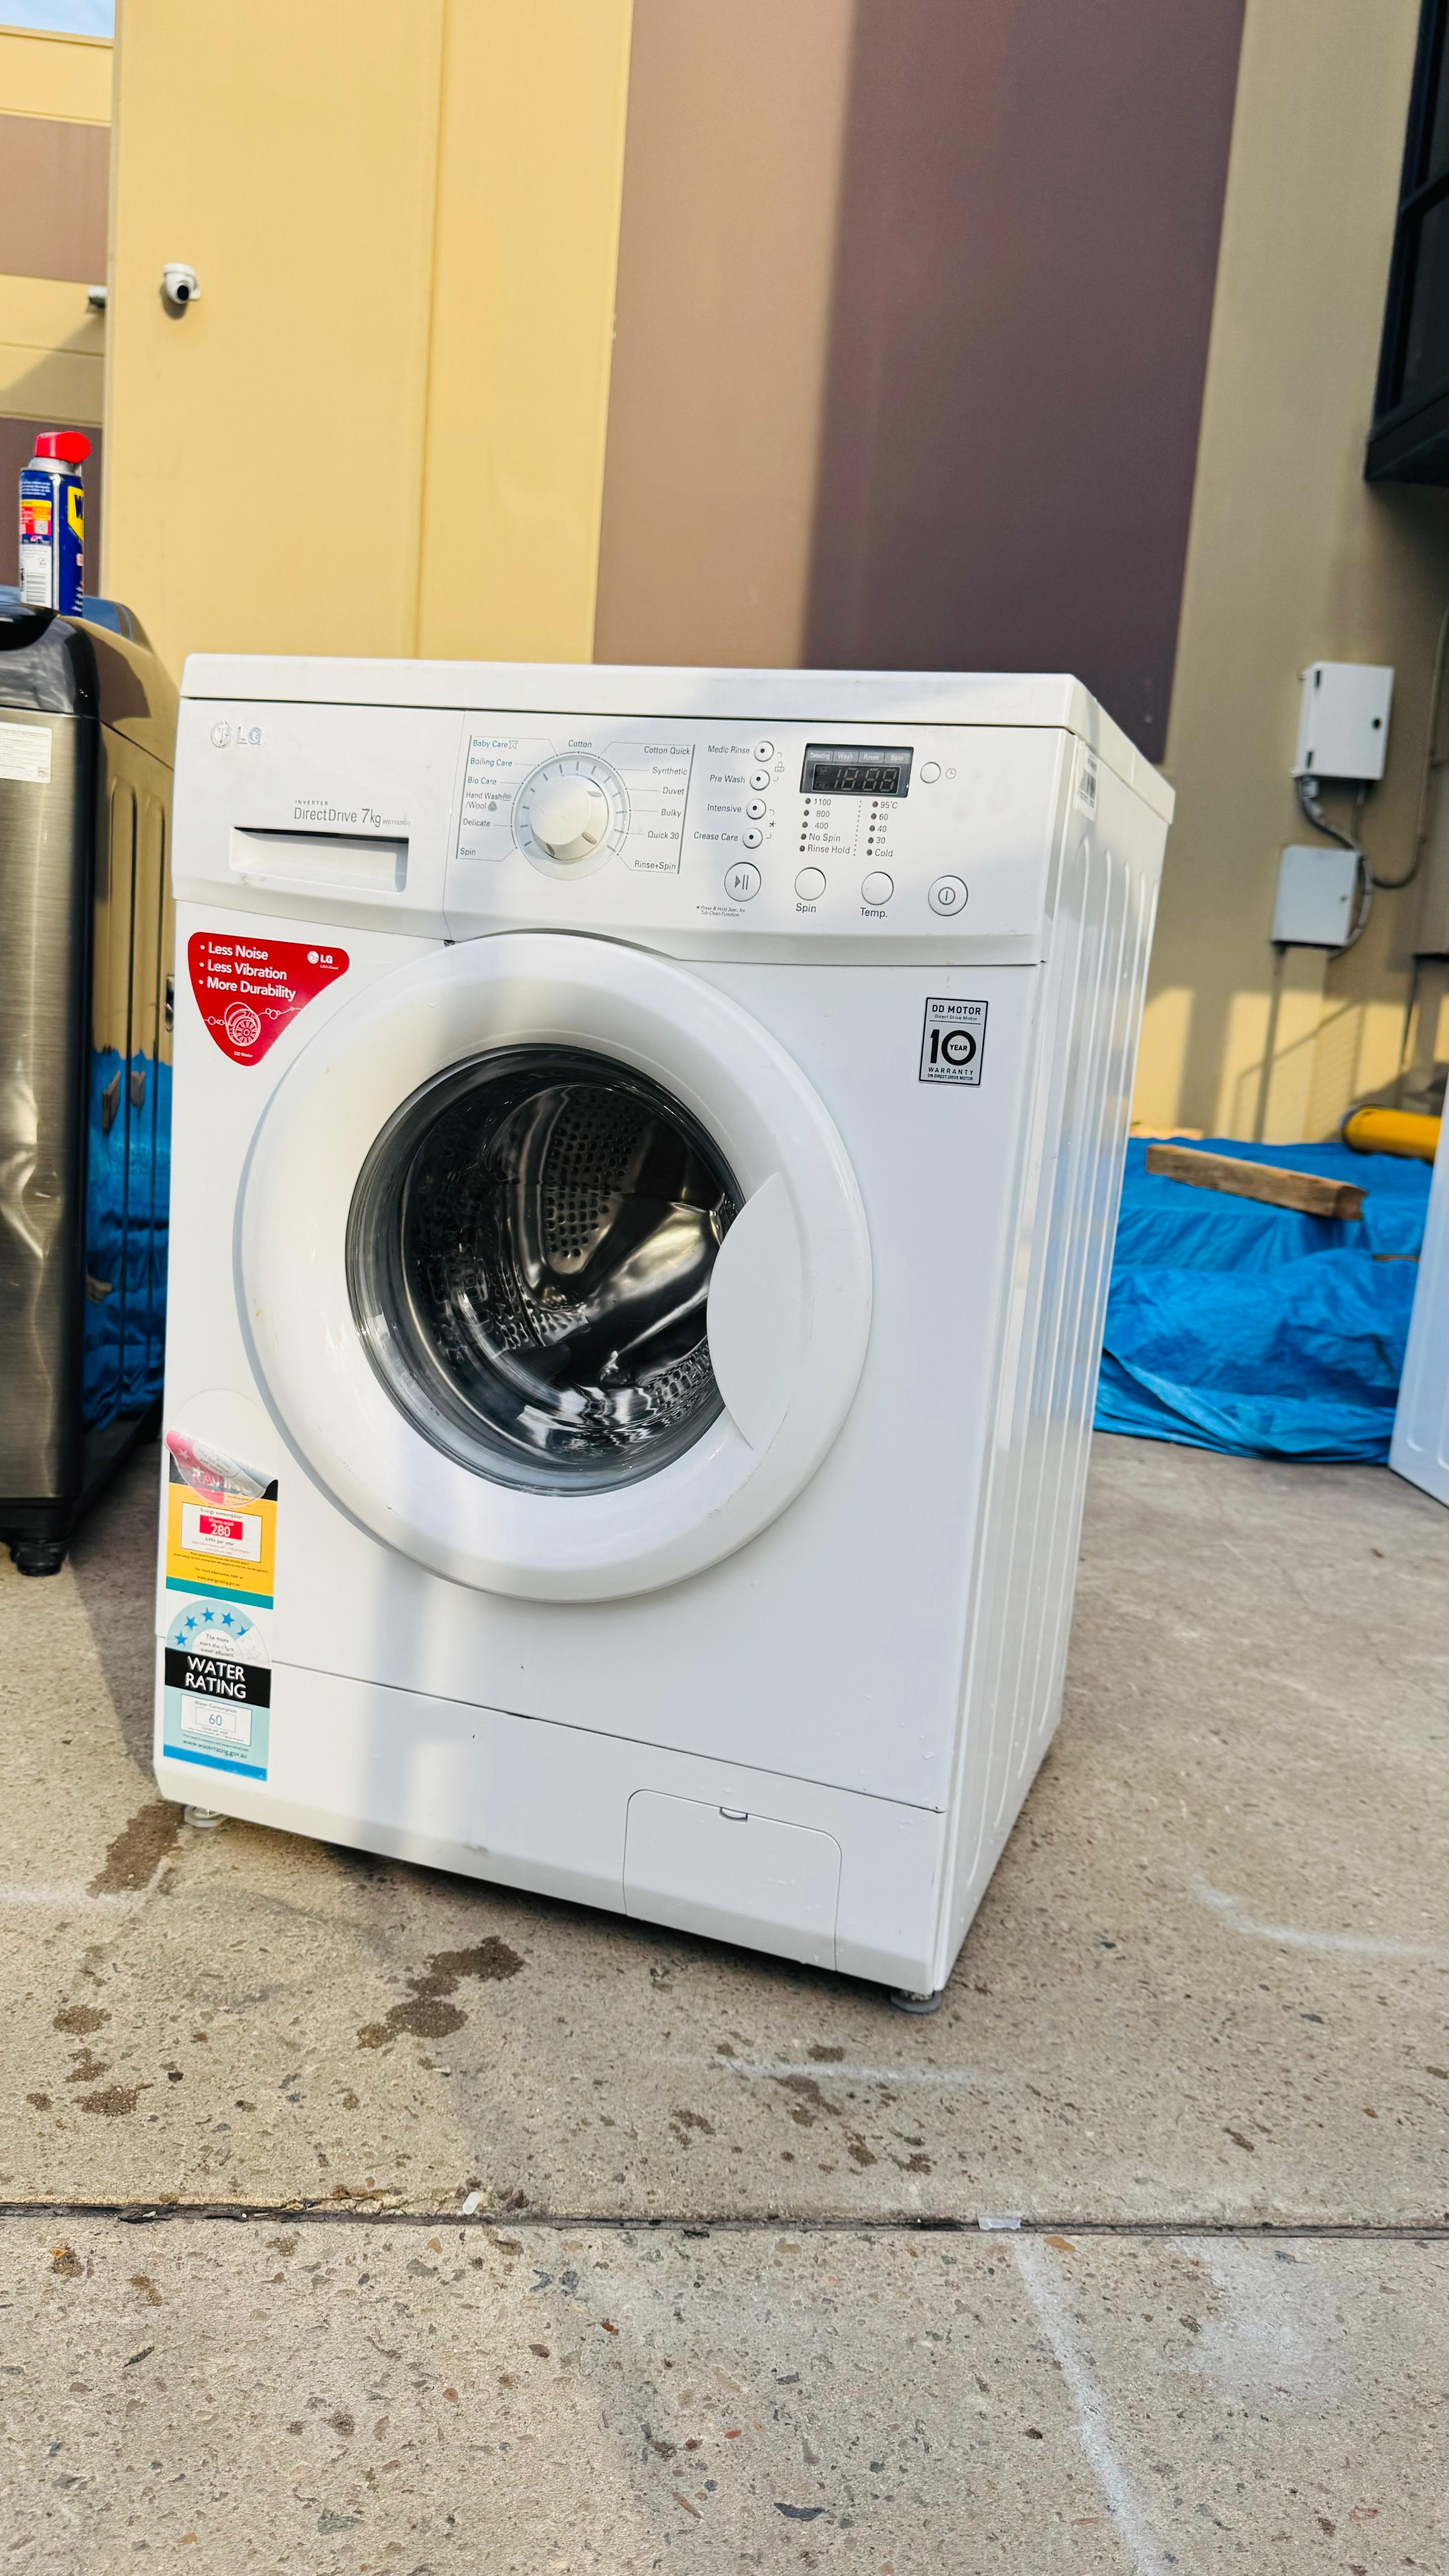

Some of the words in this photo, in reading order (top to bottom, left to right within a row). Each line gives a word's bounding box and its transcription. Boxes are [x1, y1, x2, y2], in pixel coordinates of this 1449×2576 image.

[237, 727, 262, 745] LG
[473, 740, 490, 749] Baby
[569, 740, 592, 748] Cotton
[644, 746, 668, 754] Cotton
[670, 747, 690, 755] Quick
[708, 745, 729, 753] Medic
[731, 746, 750, 754] Rinse
[470, 757, 495, 767] Boiling
[496, 759, 512, 767] Care
[653, 767, 688, 775] Synthetic
[480, 777, 497, 785] Care
[709, 774, 722, 782] Pre
[725, 775, 746, 783] Wash
[466, 791, 482, 799] Hand
[663, 786, 684, 795] Duvet
[707, 803, 742, 813] Intensive
[362, 809, 381, 828] 7kg
[661, 809, 682, 818] Bulky
[463, 818, 491, 827] Delicate
[648, 830, 669, 839] Quick
[694, 831, 719, 840] Crease
[721, 833, 739, 841] Care
[809, 833, 821, 841] No
[823, 833, 841, 843] Spin
[460, 847, 476, 856] Spin
[808, 844, 829, 853] Rinse
[832, 846, 850, 854] Hold
[875, 849, 893, 857] Cold
[634, 860, 676, 870] Rinse+Spin
[795, 903, 817, 914] Spin
[860, 907, 888, 919] Temp.
[208, 941, 233, 956] Less
[235, 944, 269, 960] Noise
[320, 954, 333, 964] LG
[207, 958, 232, 974] Less
[234, 961, 287, 981] Vibration
[207, 976, 238, 992] More
[240, 980, 296, 1002] Durability
[932, 1004, 944, 1013] DD
[948, 1005, 981, 1015] MOTOR
[930, 1029, 977, 1066] 10
[928, 1067, 974, 1075] WARRANTY
[210, 1523, 231, 1538] 280
[187, 1655, 246, 1681] WATER
[185, 1672, 246, 1699] RATING
[209, 1714, 222, 1726] 60
